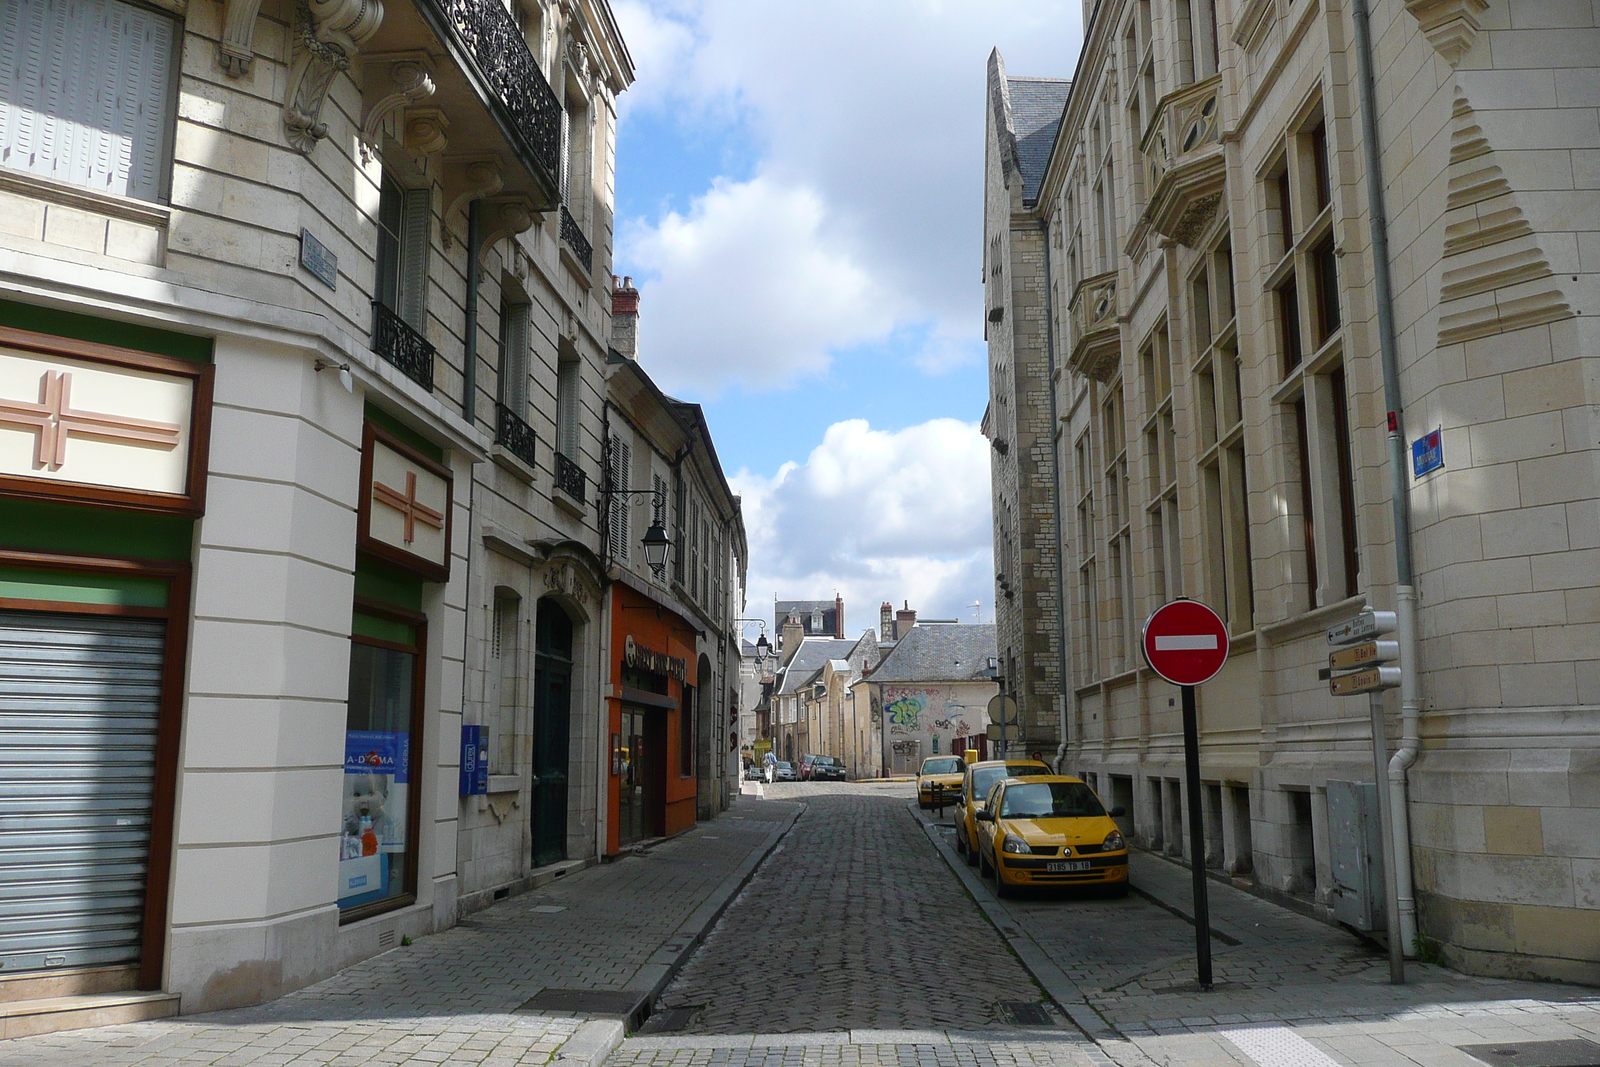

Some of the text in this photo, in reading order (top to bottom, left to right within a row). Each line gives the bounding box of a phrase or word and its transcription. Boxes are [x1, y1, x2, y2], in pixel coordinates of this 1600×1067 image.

[466, 746, 475, 769] durex
[1048, 861, 1090, 871] 3185 TB 18
